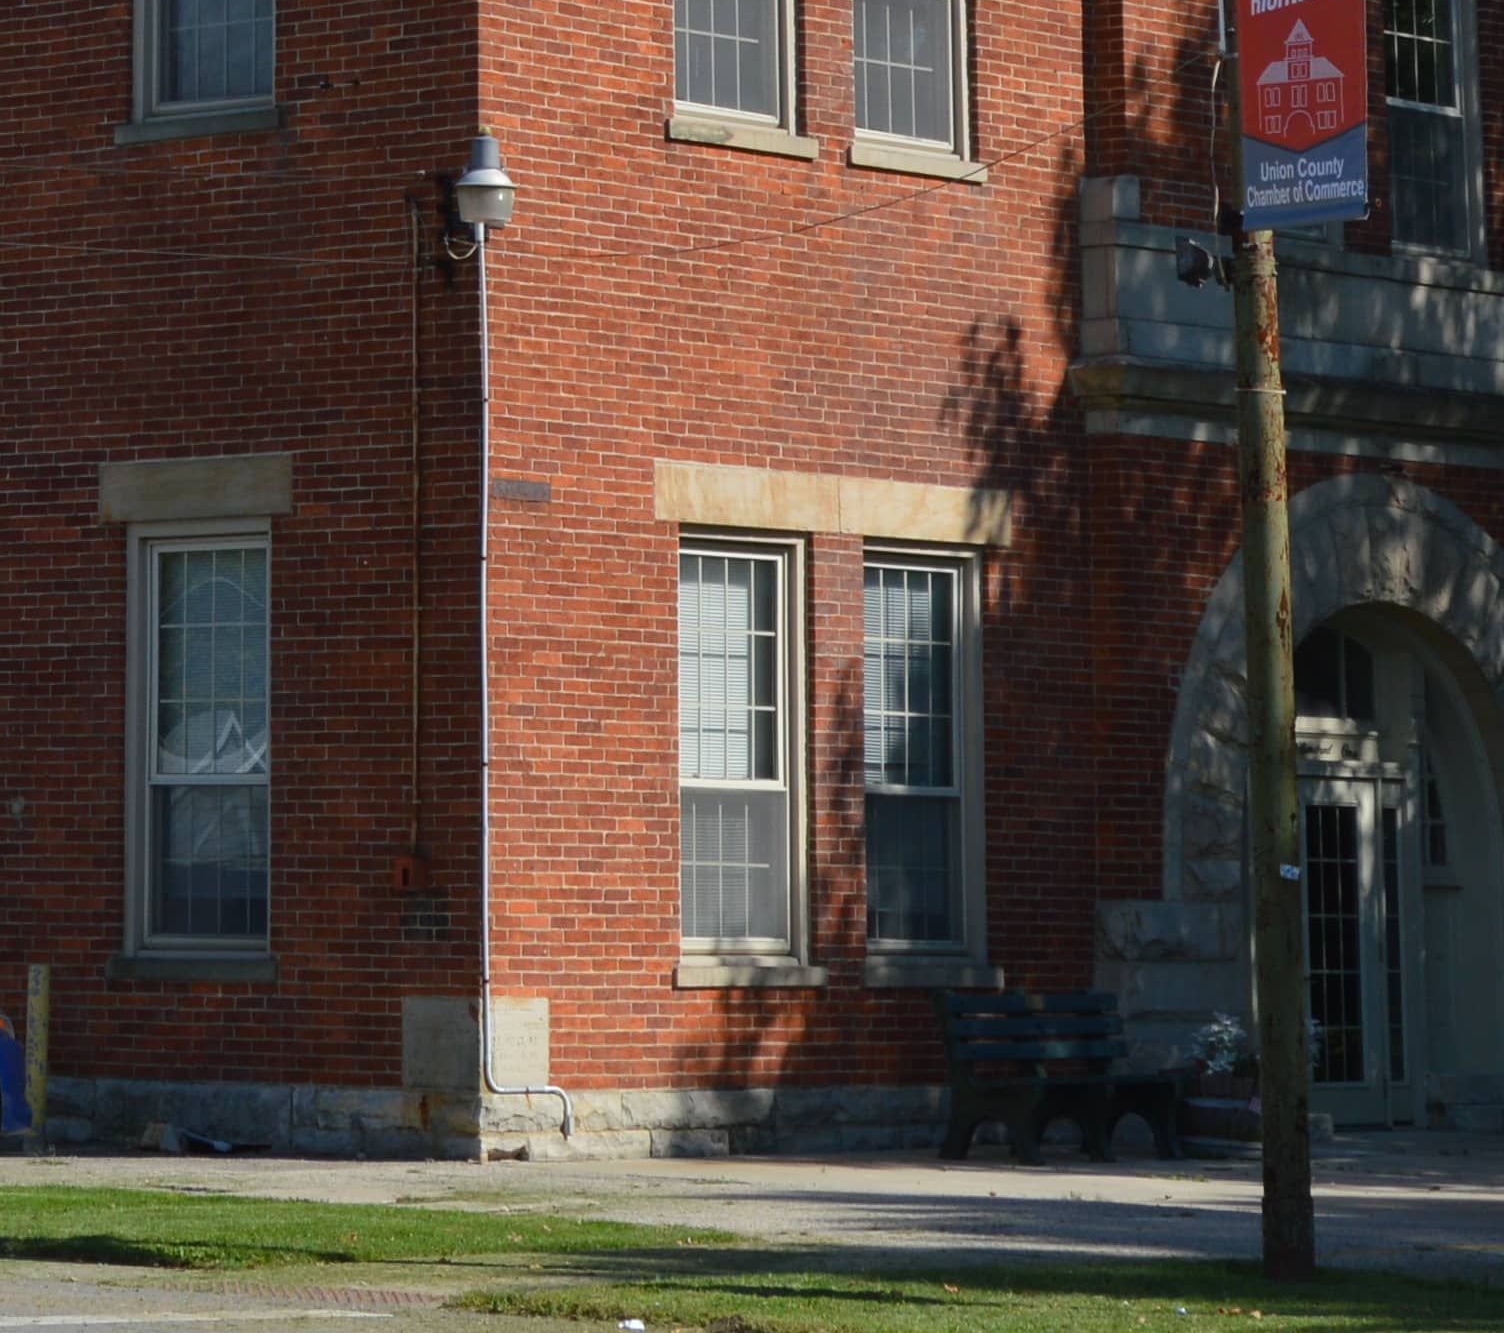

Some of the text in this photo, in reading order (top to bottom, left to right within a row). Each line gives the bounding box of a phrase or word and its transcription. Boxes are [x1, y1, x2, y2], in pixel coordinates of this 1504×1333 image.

[1260, 155, 1344, 182] Union County
[1247, 177, 1364, 209] Chamber of Commerce
